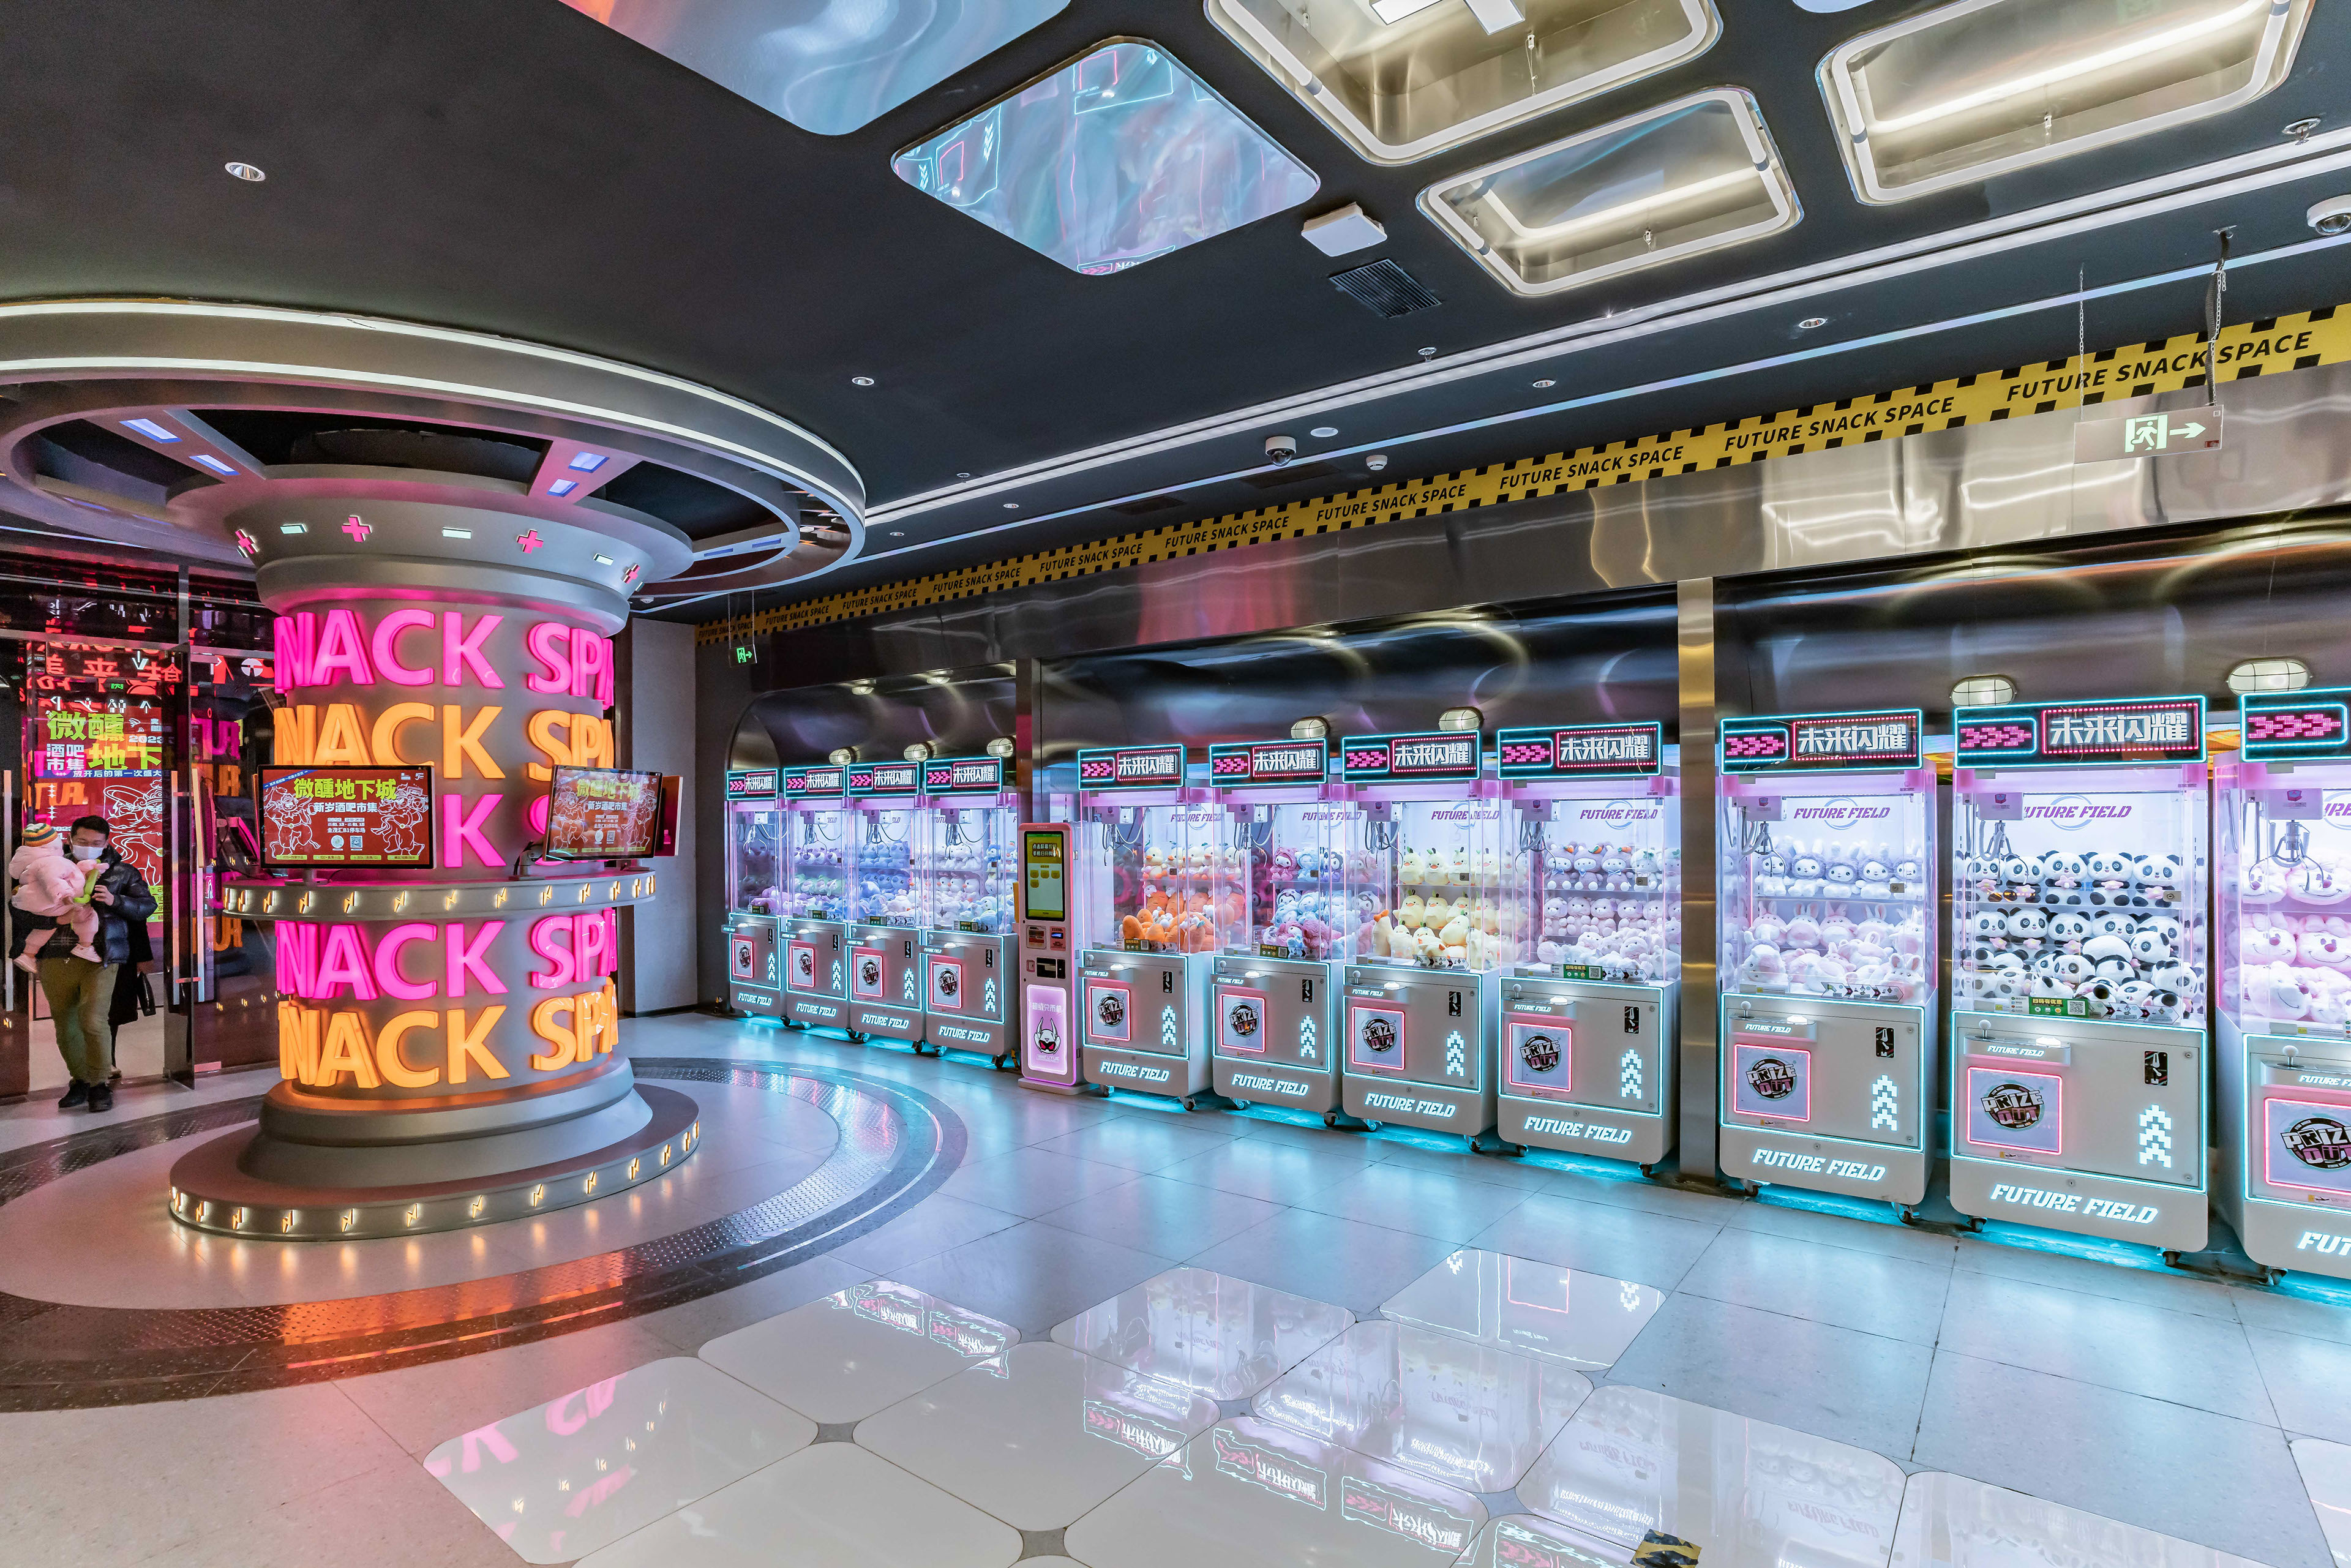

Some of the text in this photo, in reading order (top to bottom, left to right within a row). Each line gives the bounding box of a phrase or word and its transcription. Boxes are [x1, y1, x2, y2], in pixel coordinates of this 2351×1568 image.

[2007, 331, 2314, 402] FUTURE SNACK SPACE
[1724, 397, 1955, 452] FUTURE SNACK SPACE
[1500, 446, 1684, 489] FUTURE SNACK SPACE
[1316, 484, 1467, 522] FUTURE SNACK SPACE
[1165, 516, 1289, 549] FUTURE SNACK SPACE
[1040, 543, 1144, 572] FUTURE SNACK SPACE
[933, 567, 1021, 593] FUTURE SNACK SPACE
[842, 588, 917, 610] FUTURE SNACK SPACE
[766, 605, 829, 625] FUTURE SNACK SPACE
[699, 621, 754, 637] FUTURE SNACK SPACE
[1798, 724, 1907, 753] 未来闪耀
[2050, 712, 2188, 746] 未来闪耀
[47, 744, 84, 757] 酒吧
[1394, 742, 1470, 766] 未来闪耀
[1561, 735, 1649, 761] 未来闪耀
[47, 758, 84, 770] 市集
[1119, 754, 1174, 775] 未来闪耀
[1254, 749, 1318, 772] 未来闪耀
[745, 776, 773, 790] 未来闪耀
[807, 773, 841, 788] 未来闪耀
[874, 770, 913, 786] 未来闪耀
[953, 765, 994, 784] 未来闪耀
[293, 778, 397, 801] 微醺地下城
[313, 802, 378, 813] 新岁酒吧市集
[1431, 810, 1468, 820] FUTURE
[1580, 809, 1658, 820] FUTURE FIELD
[1793, 806, 1890, 819] FUTURE FIELD
[2082, 805, 2132, 818] FIELD
[738, 992, 772, 1006] FUTURE FIELD
[1098, 999, 1124, 1015] PRIZE
[797, 1003, 838, 1018] FUTURE FIELD
[1103, 1011, 1123, 1024] OUT
[1229, 1009, 1259, 1025] PRIZE
[861, 1014, 910, 1029] FUTURE FIELD
[939, 1026, 991, 1043] FUTURE FIELD
[1362, 1022, 1397, 1041] PRIZE
[1370, 1035, 1394, 1049] OUT
[1520, 1040, 1561, 1059] PRIZE
[1987, 1045, 2044, 1057] FUTURE FIELD
[1529, 1053, 1558, 1069] OUT
[1100, 1060, 1170, 1082] FUTURE FIELD
[1745, 1063, 1797, 1084] PRIZE
[2298, 1075, 2341, 1086] FUTURE
[1231, 1073, 1309, 1097] FUTURE FIELD
[1758, 1079, 1793, 1096] OUT
[1365, 1092, 1456, 1118] FUTURE FIELD
[1980, 1089, 2044, 1112] PRIZE
[1995, 1106, 2040, 1125] OUT
[1524, 1116, 1632, 1144] FUTURE FIELD
[1752, 1149, 1886, 1182] FUTURE FIELD
[1990, 1183, 2159, 1225] FUTURE FIELD
